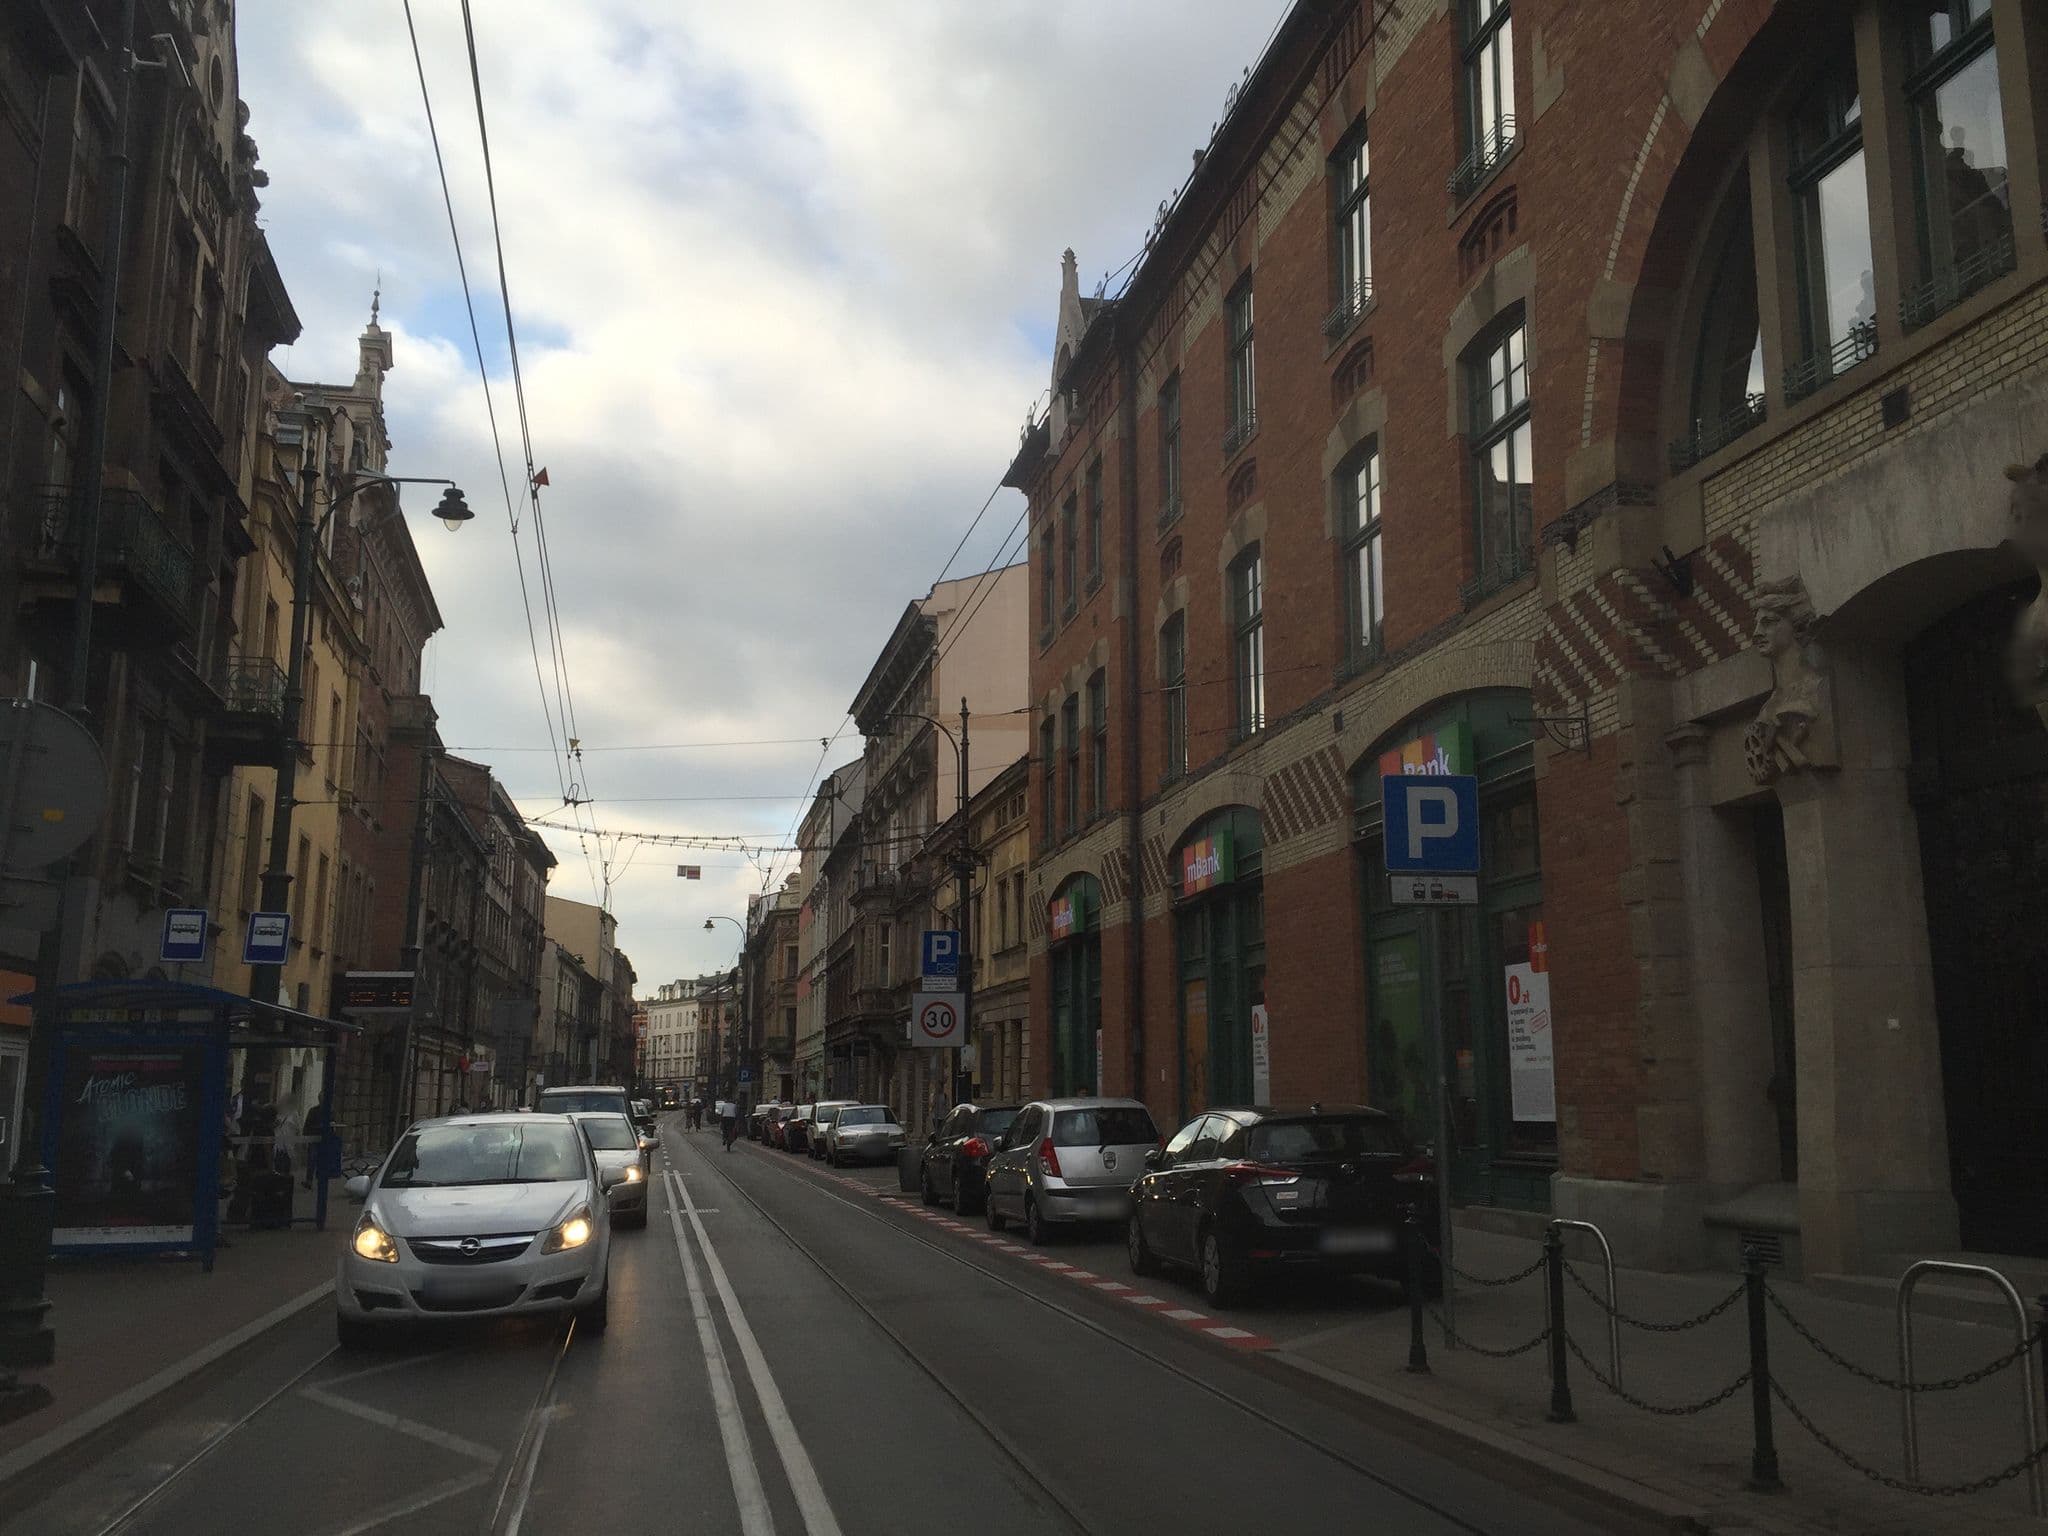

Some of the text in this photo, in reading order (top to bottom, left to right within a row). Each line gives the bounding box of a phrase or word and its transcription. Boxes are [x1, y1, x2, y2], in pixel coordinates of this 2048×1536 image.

[1406, 786, 1459, 858] P
[1187, 848, 1221, 883] mBank
[931, 934, 952, 962] P
[1509, 975, 1521, 1005] 0
[926, 1011, 951, 1028] 30
